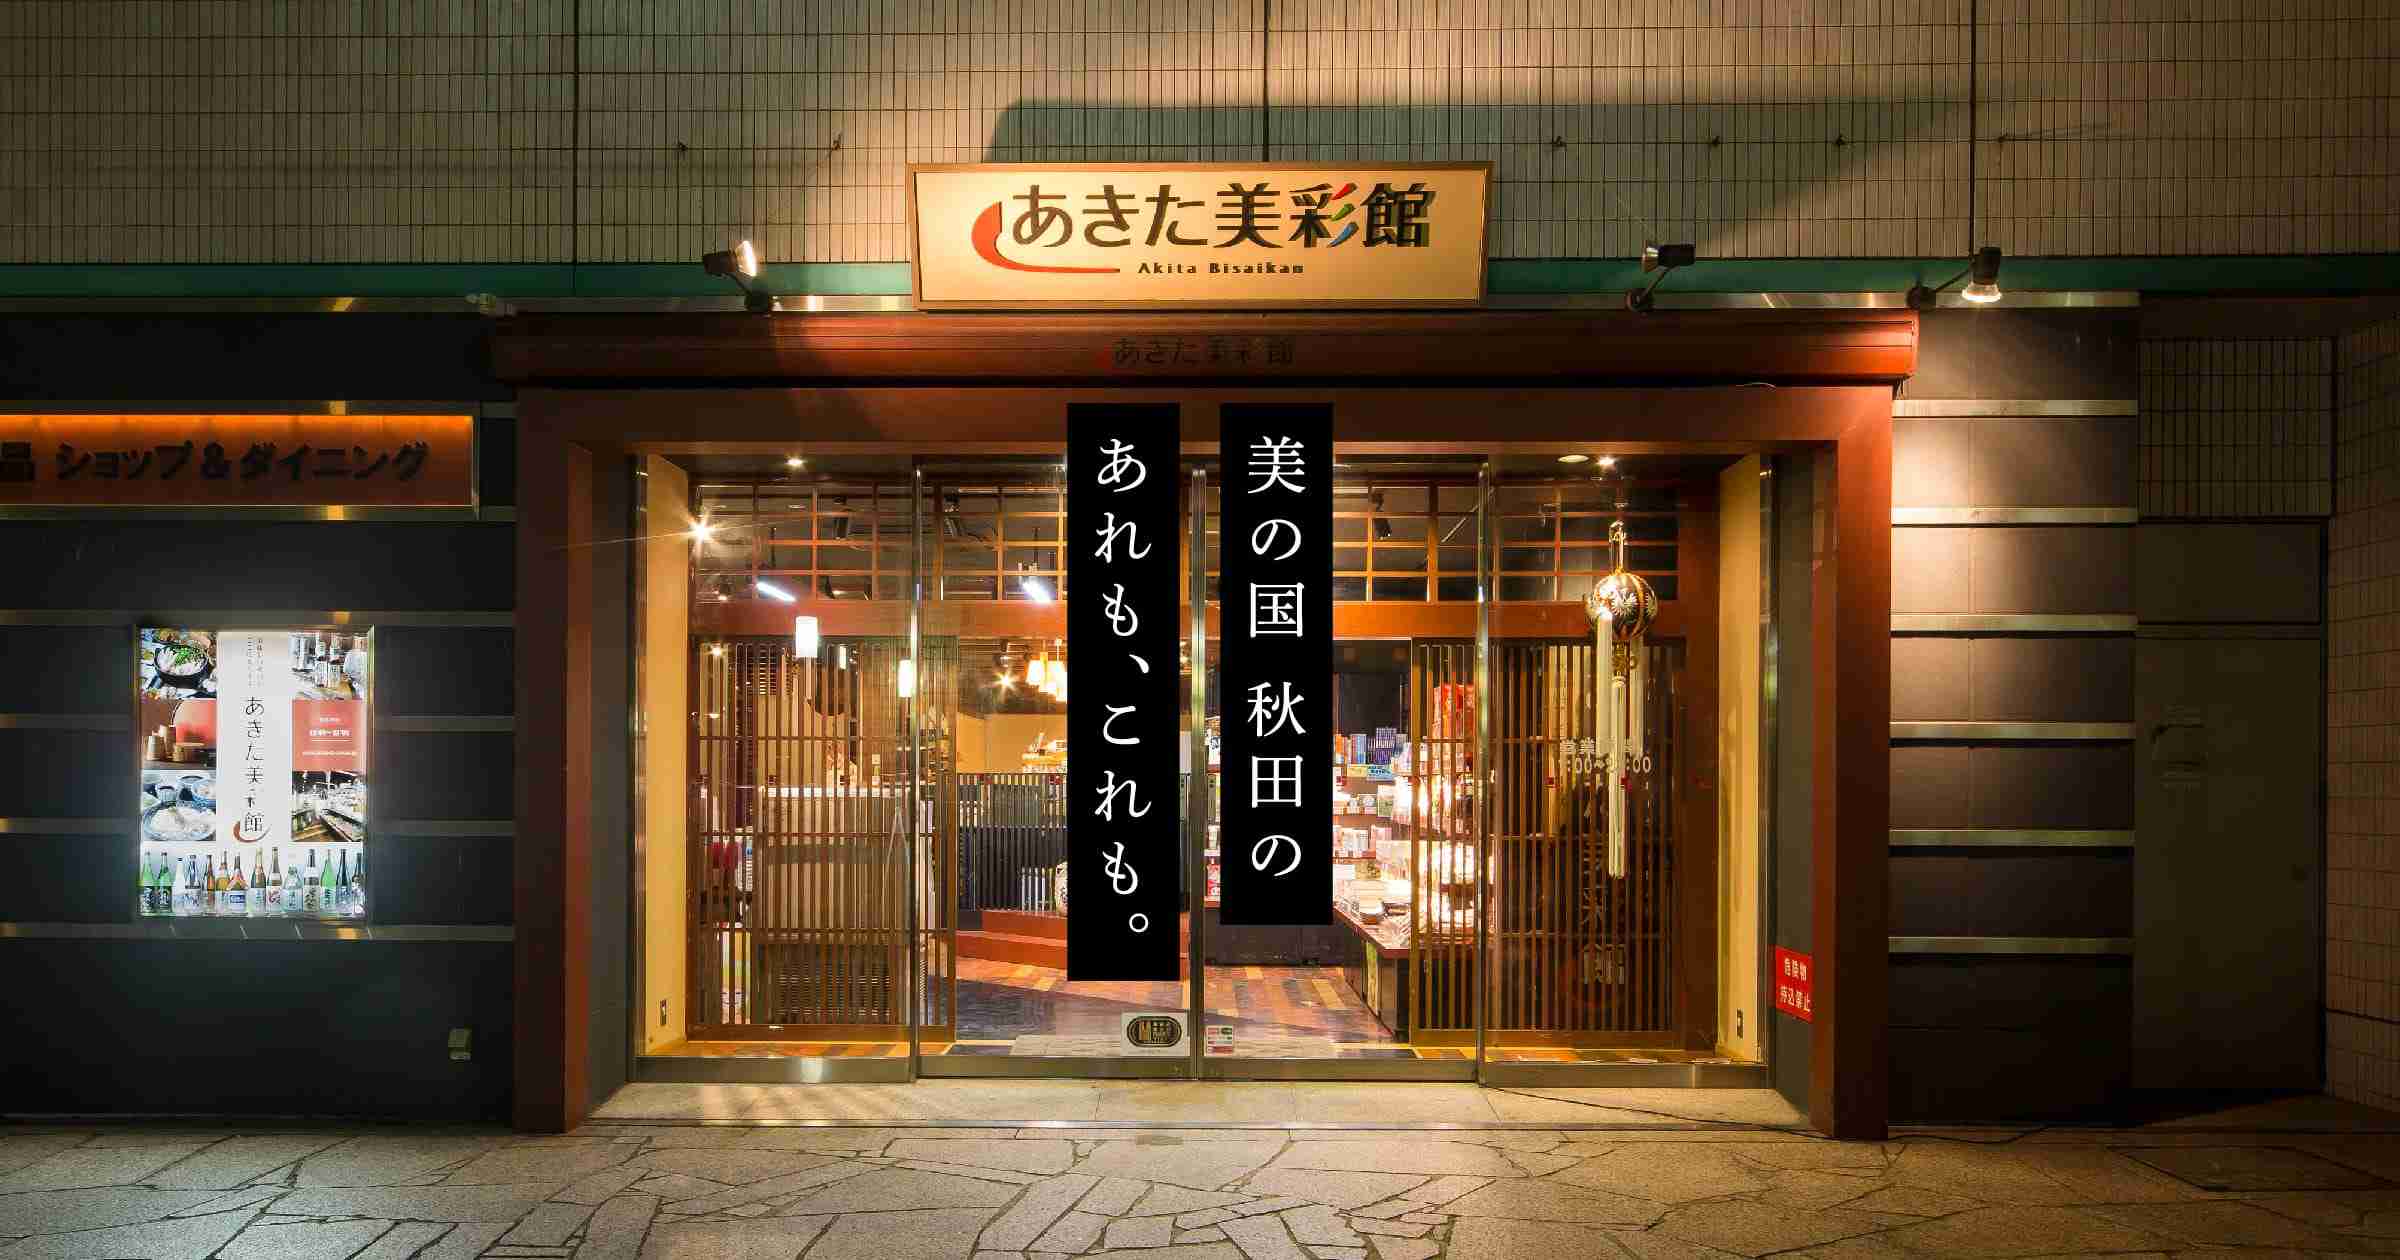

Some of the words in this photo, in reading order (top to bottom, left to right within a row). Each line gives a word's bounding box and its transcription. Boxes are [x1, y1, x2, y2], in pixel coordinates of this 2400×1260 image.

[1013, 182, 1436, 249] あきた美彩館
[1137, 262, 1198, 275] Akita
[1208, 261, 1304, 275] Bisaikan
